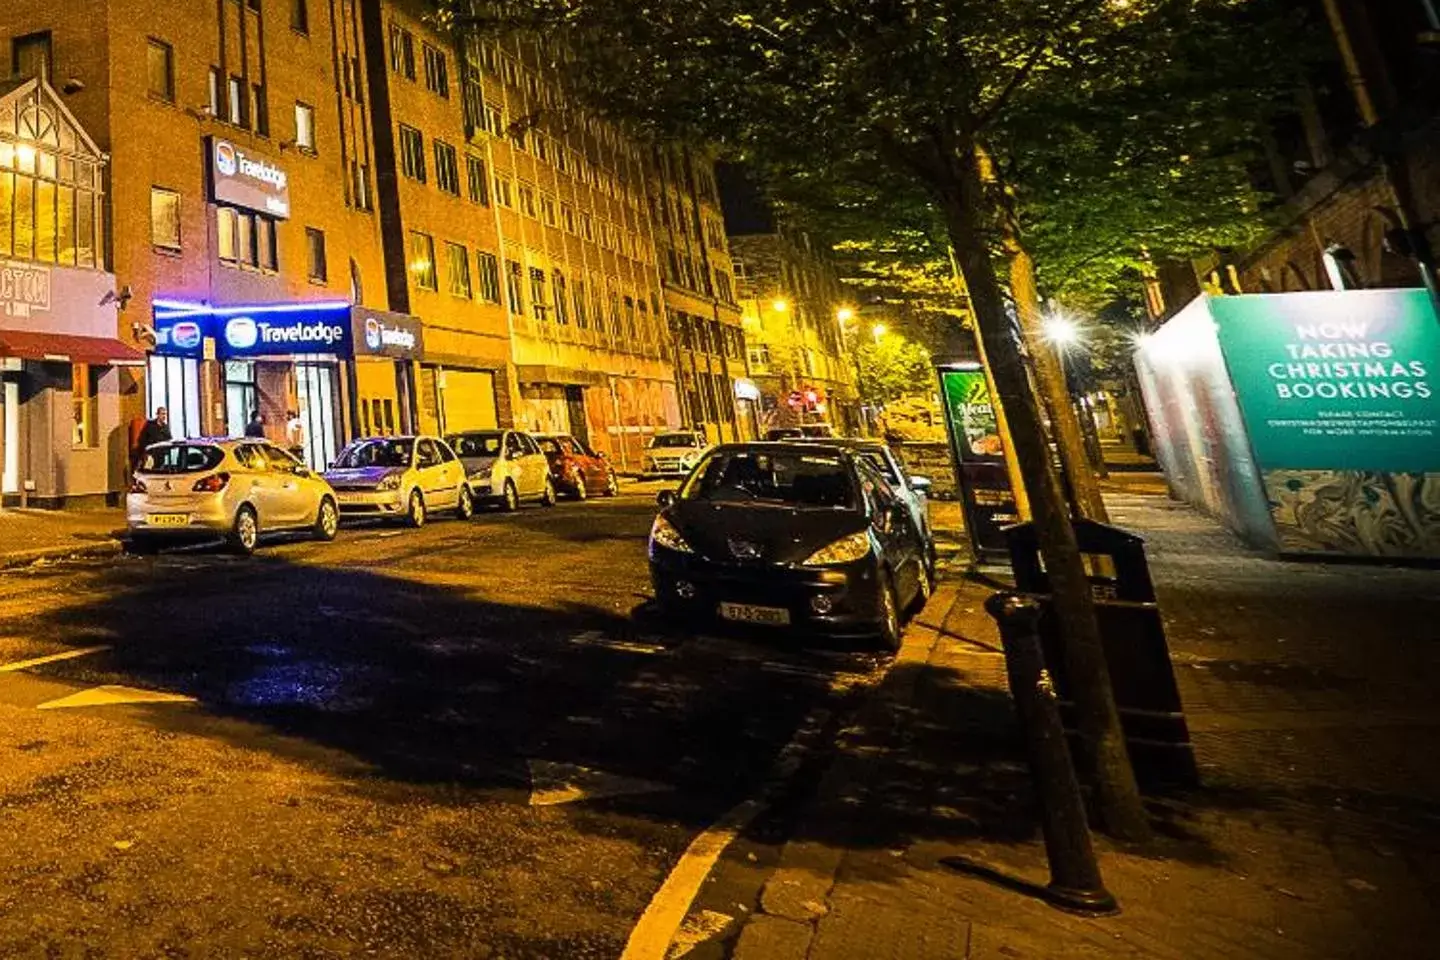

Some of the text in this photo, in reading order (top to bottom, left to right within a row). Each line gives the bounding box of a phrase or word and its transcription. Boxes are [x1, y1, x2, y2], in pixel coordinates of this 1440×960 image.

[235, 151, 286, 191] Travelodge
[257, 321, 343, 344] Travelodge
[1295, 320, 1368, 340] NOW
[1285, 342, 1393, 360] TAKING
[1268, 360, 1426, 379] CHRISTMAS
[1276, 381, 1432, 398] BOOKINGS
